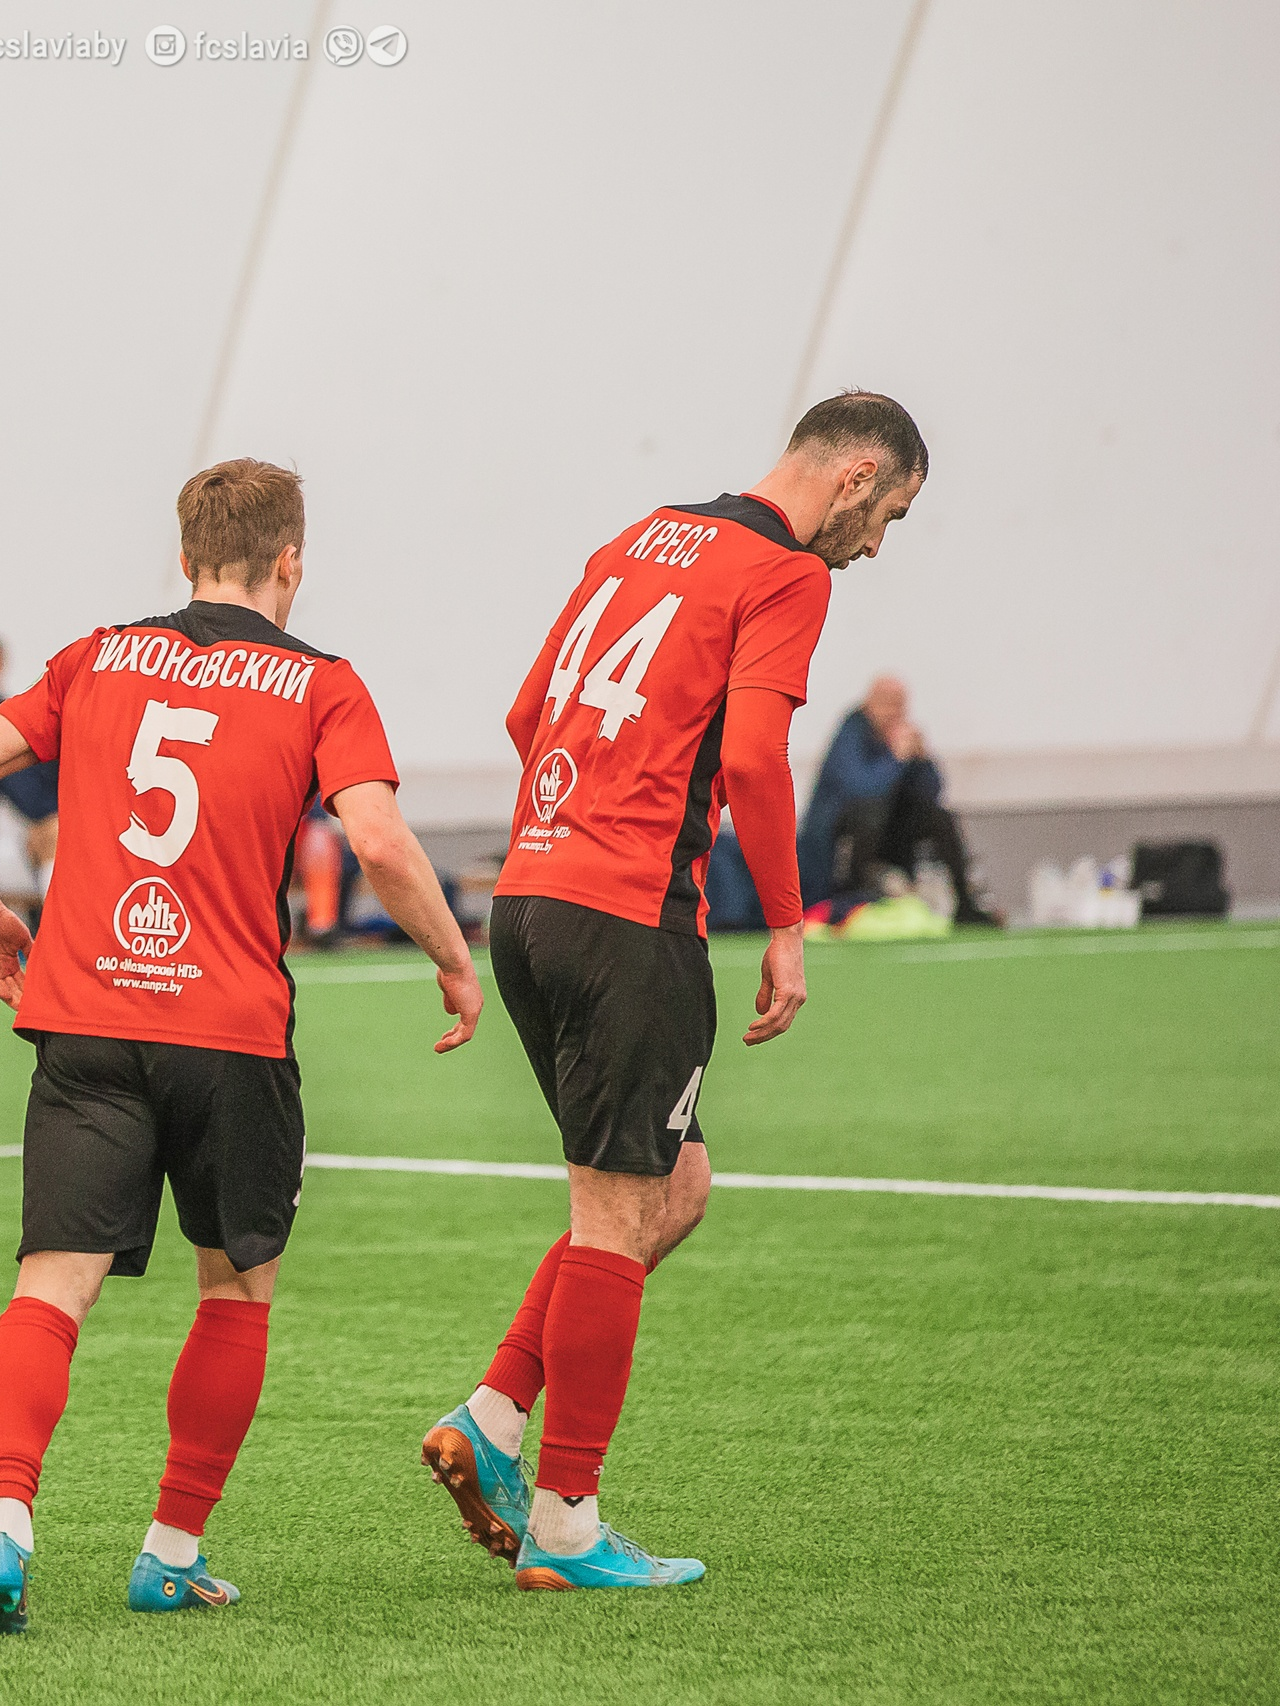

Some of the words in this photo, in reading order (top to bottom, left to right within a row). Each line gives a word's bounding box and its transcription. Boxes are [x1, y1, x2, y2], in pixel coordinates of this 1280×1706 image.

[625, 517, 718, 569] КРЕСС
[545, 575, 684, 742] 44
[118, 699, 220, 868] 5
[96, 956, 118, 971] ОАО
[131, 936, 168, 958] ОАО
[113, 978, 183, 997] www.mnpz.by
